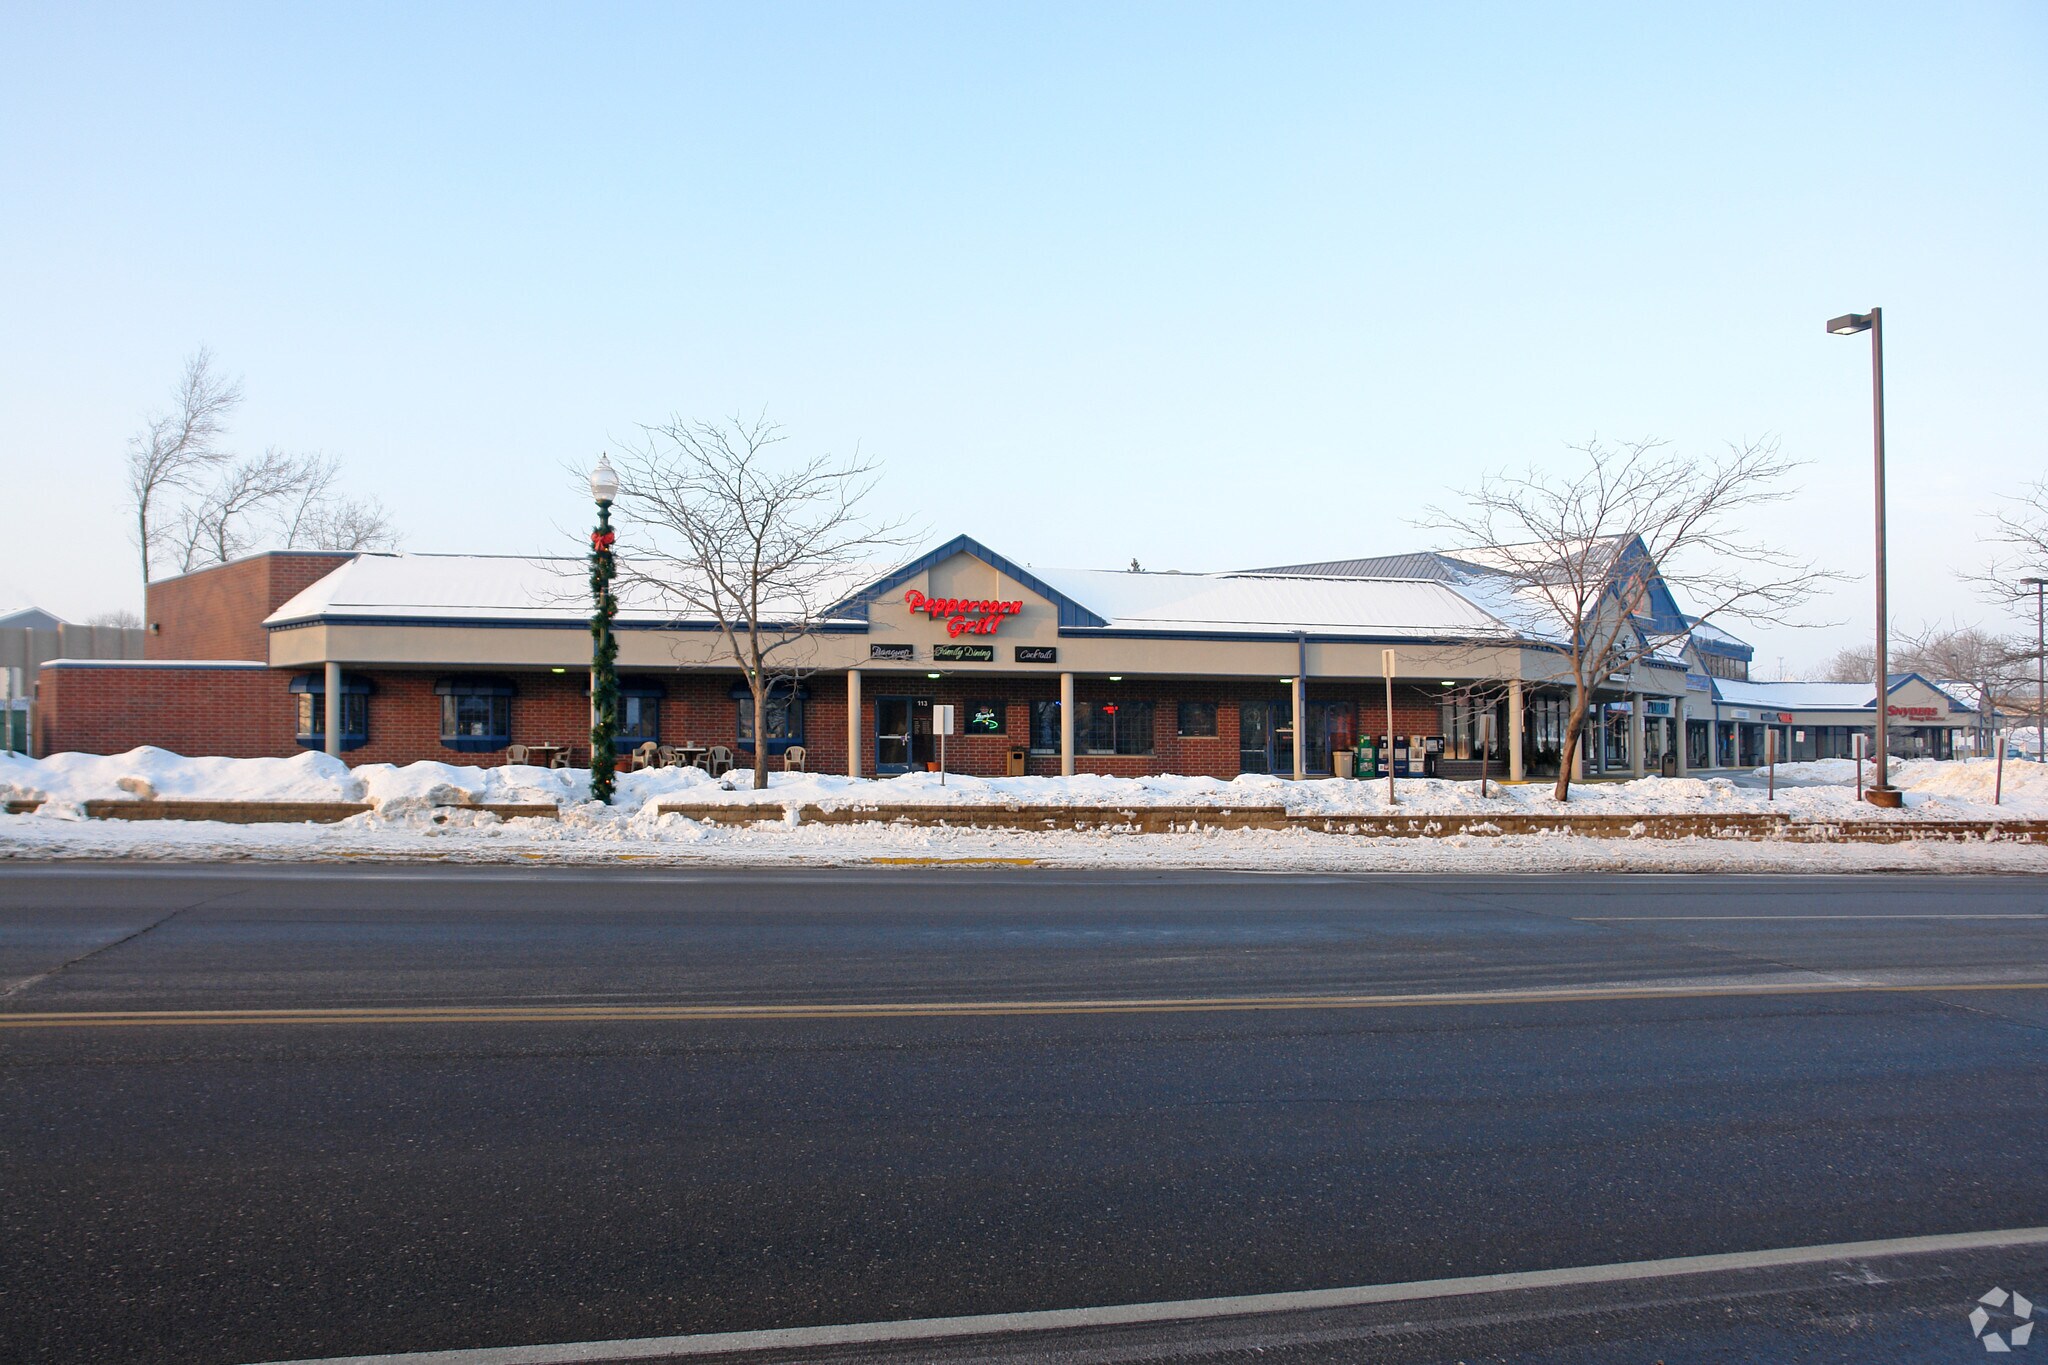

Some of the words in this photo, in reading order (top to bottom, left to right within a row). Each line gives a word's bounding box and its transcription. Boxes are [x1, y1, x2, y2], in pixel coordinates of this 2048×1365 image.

[904, 589, 1024, 618] Peppercorn
[947, 614, 1006, 638] Grill
[934, 645, 964, 660] Family
[964, 646, 992, 661] Dining
[1019, 648, 1053, 659] Cocktails
